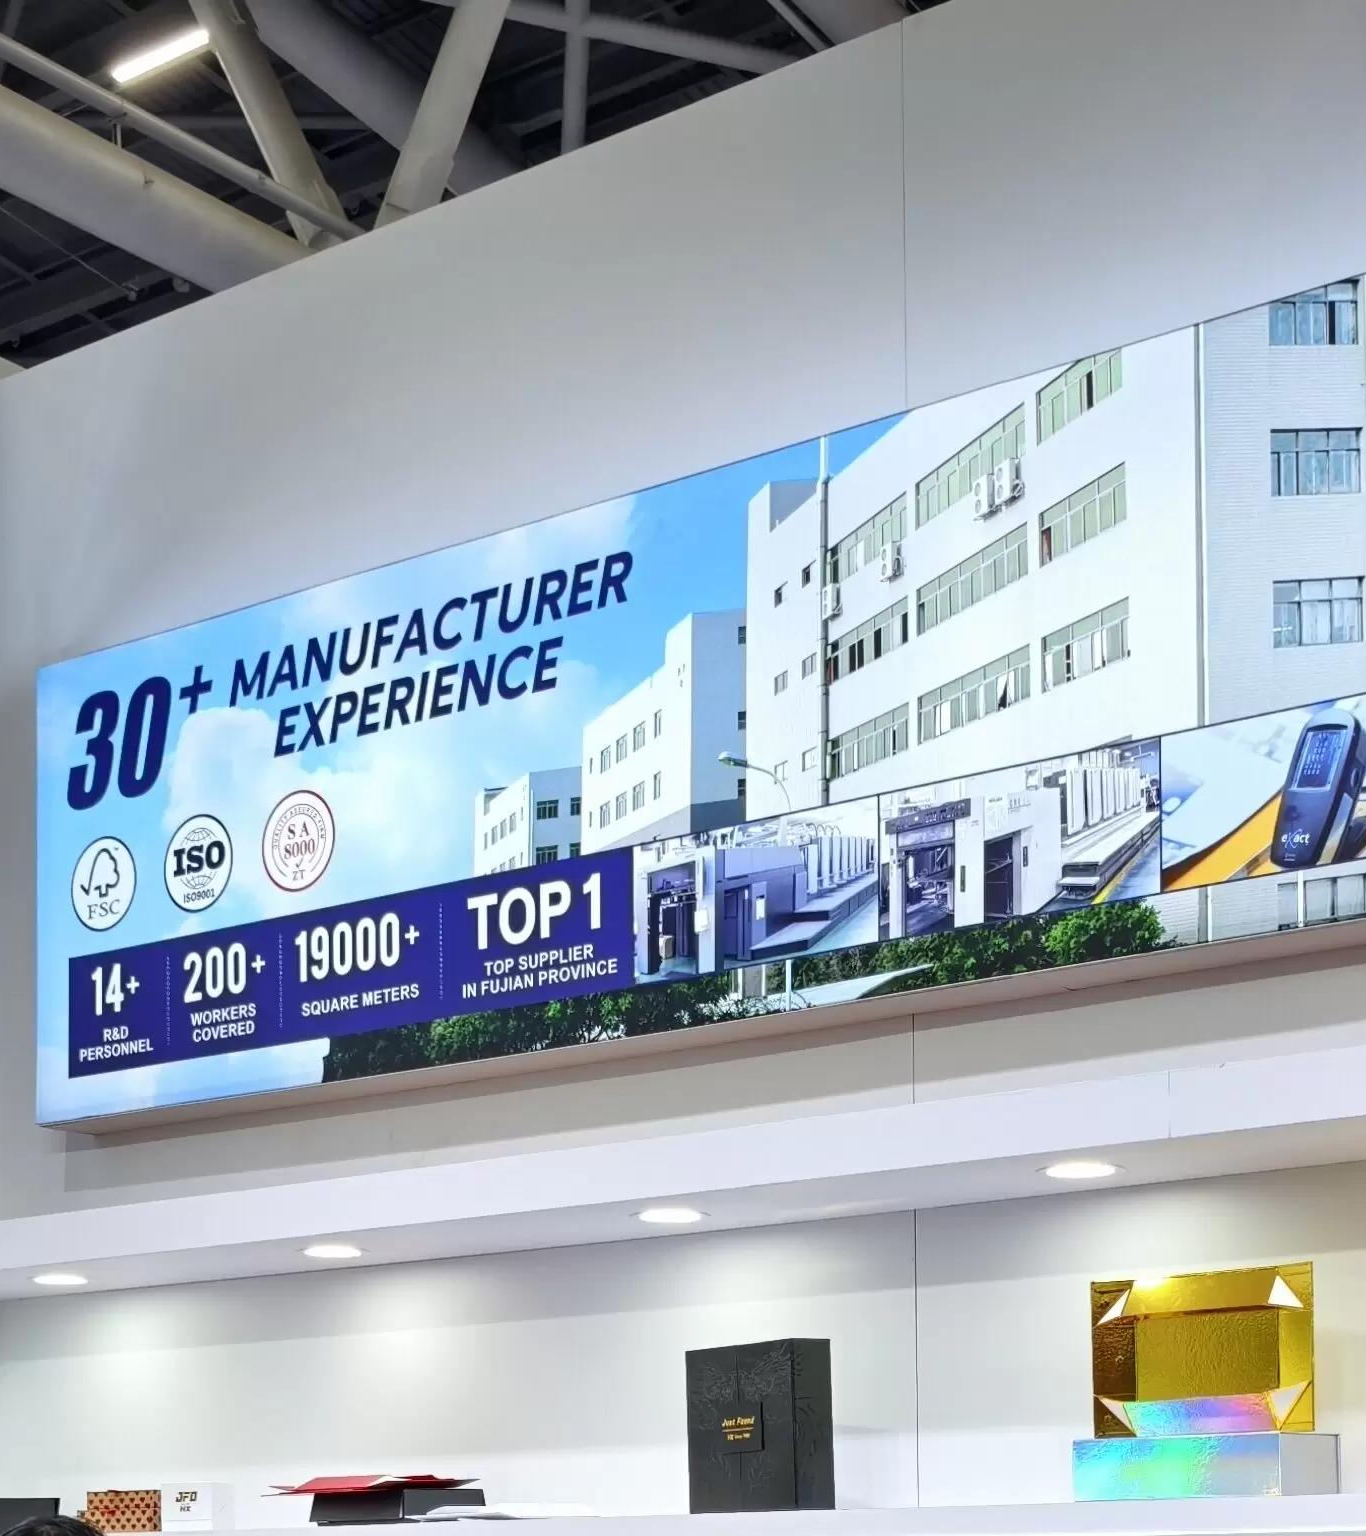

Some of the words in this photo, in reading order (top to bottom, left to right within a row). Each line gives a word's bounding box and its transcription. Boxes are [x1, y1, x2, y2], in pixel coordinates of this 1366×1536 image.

[230, 552, 633, 707] MANUFACTURER
[274, 636, 563, 757] EXPERIENCE
[67, 665, 212, 810] 30+
[174, 833, 229, 877] ISO
[284, 838, 315, 859] 8000
[87, 899, 121, 920] FSC
[183, 888, 216, 904] ISO9001
[468, 881, 570, 949] TOP
[583, 873, 600, 929] 1
[295, 913, 419, 982] 19000+
[484, 958, 514, 976] TOP
[519, 944, 593, 970] SUPPLIER
[184, 943, 265, 1003] 200+
[463, 983, 476, 998] IN
[481, 973, 533, 995] FUJIAN
[539, 958, 617, 986] PROVINCE
[92, 964, 139, 1015] 14+
[302, 994, 358, 1016] SQUARE
[362, 984, 419, 1006] METERS
[191, 1003, 256, 1026] WORKERS
[104, 1026, 128, 1042] R&D
[193, 1020, 255, 1042] COVERED
[80, 1039, 153, 1062] PERSONNEL
[722, 1418, 735, 1427] Just
[737, 1416, 755, 1426] Found
